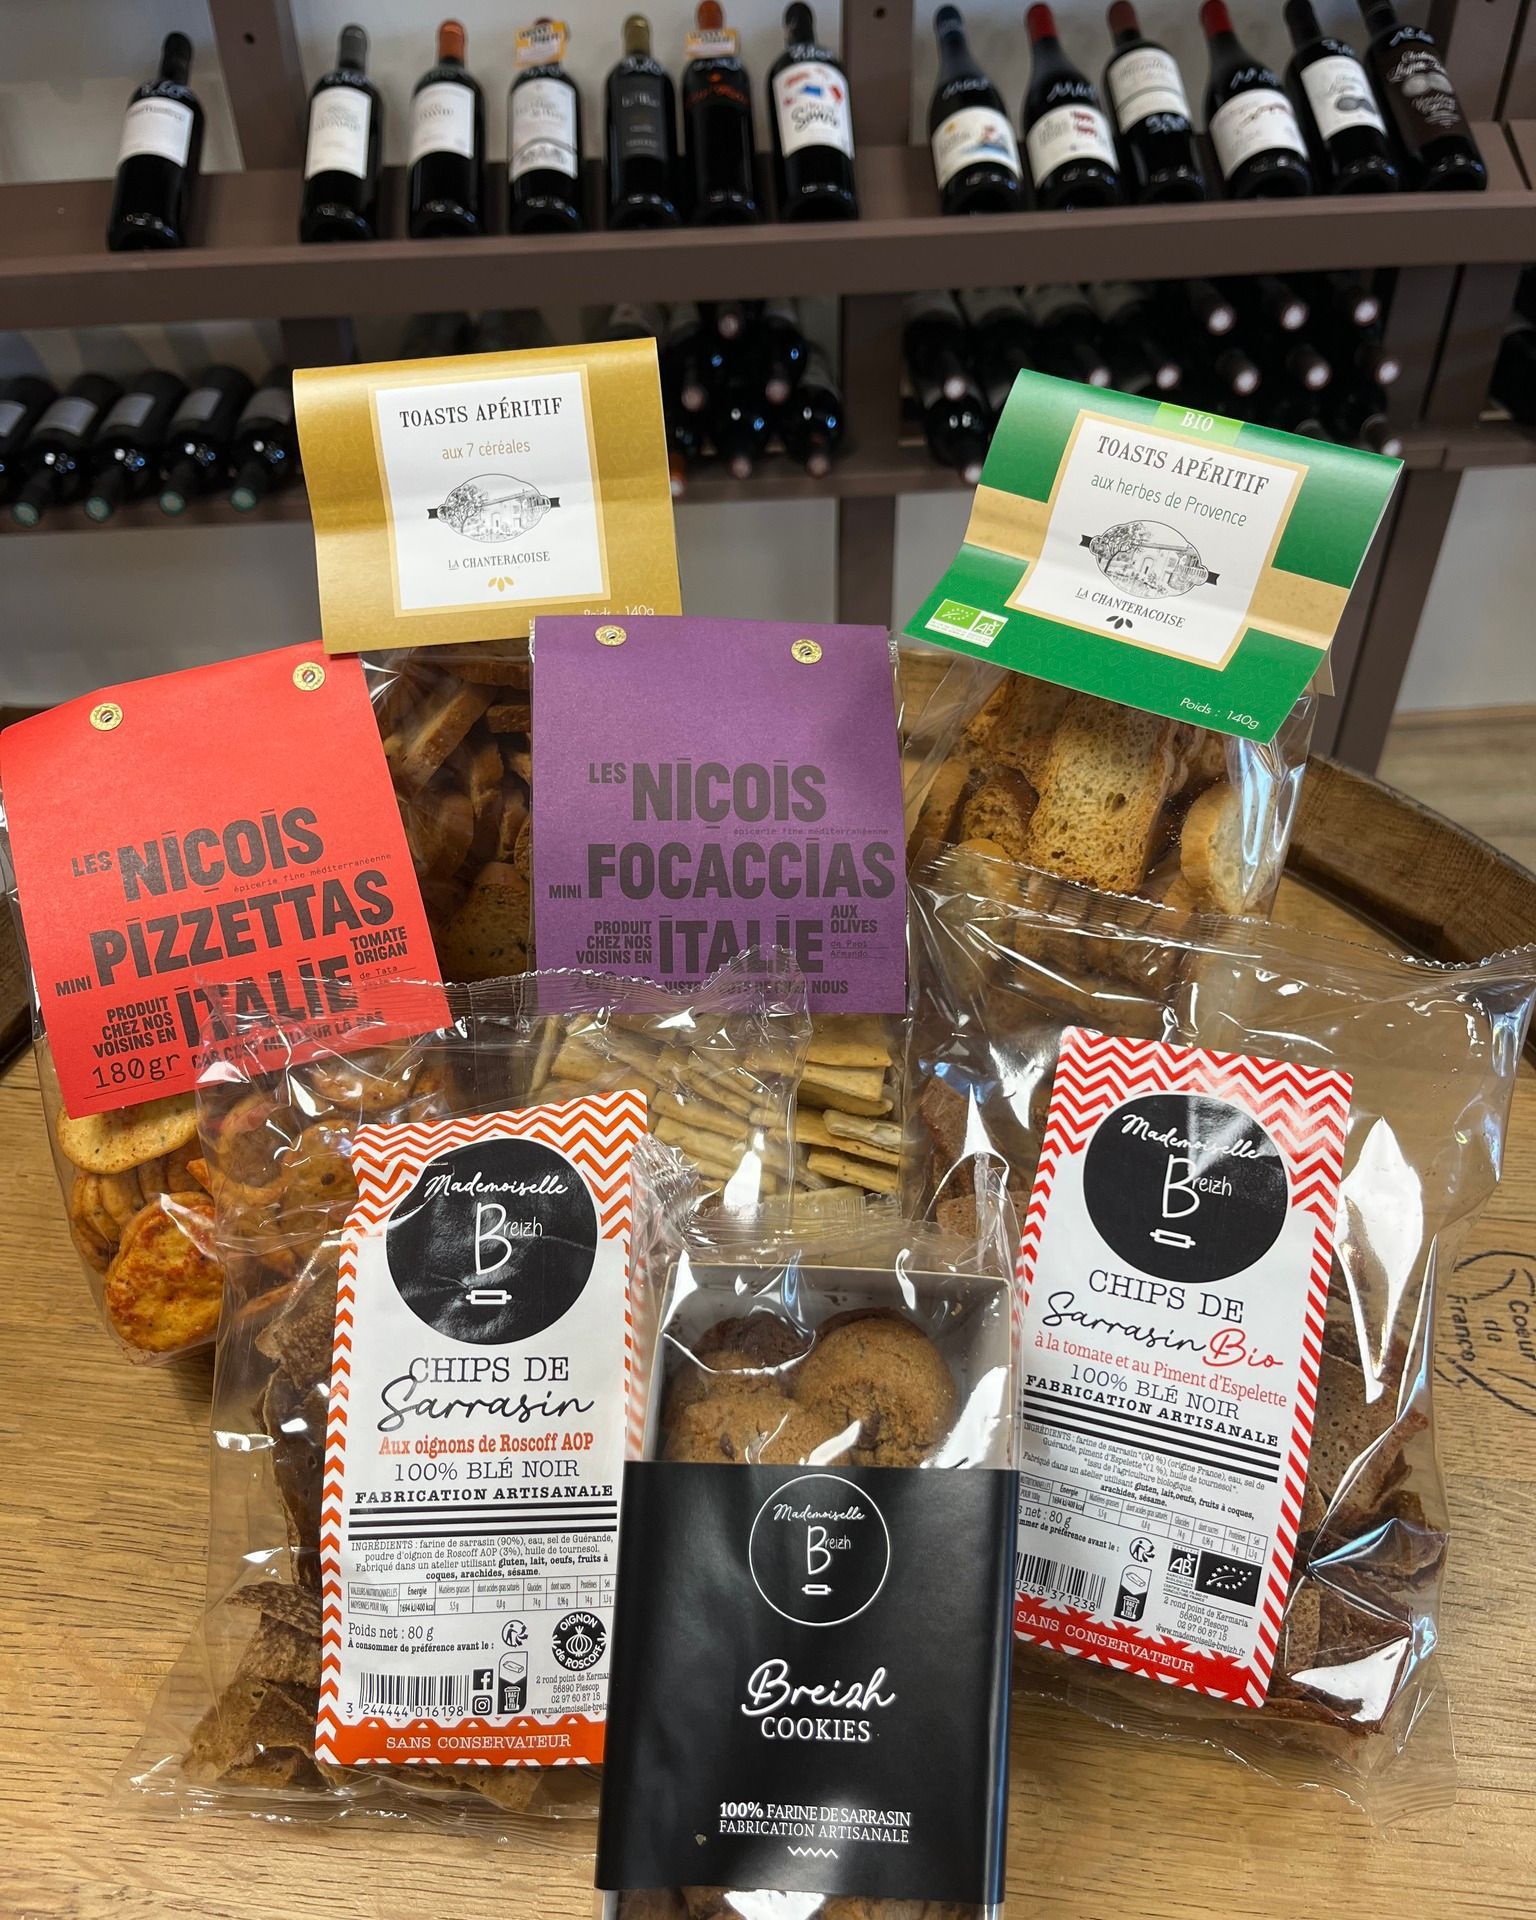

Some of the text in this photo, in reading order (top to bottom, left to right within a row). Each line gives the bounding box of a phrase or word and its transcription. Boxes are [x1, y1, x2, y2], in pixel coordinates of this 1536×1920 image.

[399, 396, 563, 428] TOASTS APÉRITIF
[1181, 411, 1214, 433] BIO
[442, 439, 531, 461] aux 7 céréales
[1097, 435, 1269, 496] TOASTS APÉRITIF
[1091, 473, 1247, 527] aux herbes de Provence
[448, 551, 550, 570] LA CHANTERACOISE
[1075, 587, 1186, 629] LA CHANTERACOISE
[1179, 698, 1260, 731] Poids 140g
[588, 762, 627, 784] LES
[71, 850, 113, 878] LES
[234, 854, 392, 893] épicerie fine méditerranéenne
[549, 838, 896, 900] MINI FOCACCIAS
[831, 904, 858, 918] AUX
[55, 870, 394, 997] MINI PIZZETTAS
[350, 926, 407, 952] TOMATE
[594, 921, 652, 935] PRODUIT
[831, 919, 878, 933] OLIVES
[354, 943, 408, 966] ORIGAN
[587, 935, 652, 950] CHEZ NOS
[576, 950, 652, 965] VOISINS EN
[811, 981, 848, 994] NOUS
[106, 997, 168, 1023] PRODUIT
[101, 1012, 173, 1041] CHEZ NOS
[93, 1027, 177, 1059] VOISINS EN
[92, 1053, 181, 1090] 180gr
[1121, 1113, 1262, 1159] Mademoiselle
[424, 1171, 569, 1197] Mademoiselle
[1162, 1153, 1232, 1219] Breizh
[474, 1202, 543, 1276] Breizh
[1089, 1269, 1244, 1324] CHIPS DE
[1042, 1291, 1284, 1367] Sarrasin Bio
[409, 1357, 569, 1384] CHIPS DE
[1034, 1332, 1288, 1408] à la tomate et au Piment d'Espelette
[377, 1374, 594, 1432] Sarrasin
[1070, 1363, 1240, 1420] 100% BLÉ NOIR
[1025, 1374, 1279, 1448] FABRICATION ARTISANALE
[379, 1432, 594, 1459] Aux oignons de Roscoff AOP
[394, 1457, 579, 1482] 100% BLÉ NOIR
[355, 1485, 613, 1504] FABRICATION ARTISANALE
[773, 1503, 866, 1521] Mademoiselle
[351, 1539, 413, 1551] INGRÉDIENTS
[419, 1540, 446, 1549] farine
[447, 1539, 458, 1548] de
[459, 1537, 498, 1547] sarrasin
[527, 1537, 545, 1546] eau,
[547, 1535, 559, 1544] sel
[561, 1535, 571, 1543] de
[572, 1534, 613, 1543] Guérande,
[365, 1552, 395, 1563] poudre
[396, 1551, 433, 1561] d'oignon
[434, 1549, 445, 1559] de
[446, 1548, 478, 1559] Roscoff
[480, 1548, 497, 1557] AOP
[524, 1546, 545, 1555] huile
[547, 1545, 557, 1554] de
[807, 1525, 851, 1575] Breizh
[356, 1562, 392, 1574] Fabriqué
[395, 1561, 416, 1571] dans
[418, 1562, 429, 1570] un
[431, 1559, 459, 1569] atelier
[461, 1558, 497, 1568] utilisant
[498, 1557, 528, 1568] gluten,
[529, 1556, 548, 1566] lait,
[550, 1556, 575, 1565] oeufs,
[577, 1554, 601, 1563] fruits
[426, 1571, 458, 1581] coques,
[460, 1569, 505, 1579] arachides,
[1170, 1558, 1192, 1576] AB
[1163, 1596, 1169, 1604] 2
[1170, 1598, 1186, 1610] rond
[1188, 1602, 1205, 1615] point
[1206, 1607, 1215, 1617] de
[348, 1622, 434, 1641] Poids net 80 g
[560, 1613, 598, 1631] OIGNON
[1016, 1610, 1194, 1673] SANS CONSERVATEUR
[555, 1645, 603, 1669] de ROSCOFF
[741, 1658, 896, 1716] Breizh
[346, 1703, 465, 1717] 3 244444 016198
[386, 1733, 571, 1749] SANS CONSERVATEUR
[761, 1716, 871, 1742] COOKIES
[719, 1801, 911, 1827] 100% FARINE DE SARRASIN
[719, 1820, 909, 1843] FABRICATION ARTISANALE
